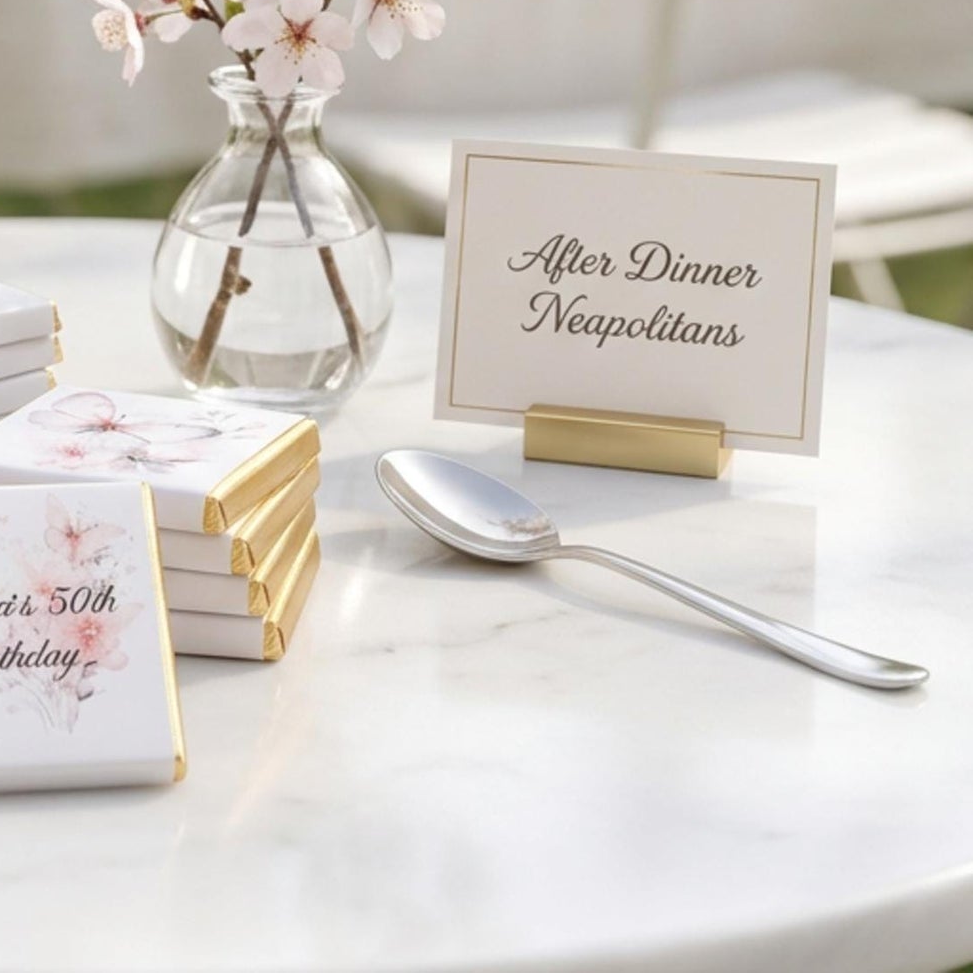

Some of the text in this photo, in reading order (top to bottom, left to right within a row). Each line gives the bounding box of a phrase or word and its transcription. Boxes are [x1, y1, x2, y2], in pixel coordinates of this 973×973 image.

[507, 234, 763, 289] After Dinner
[520, 291, 746, 348] Neapolitans
[49, 584, 119, 615] 50th
